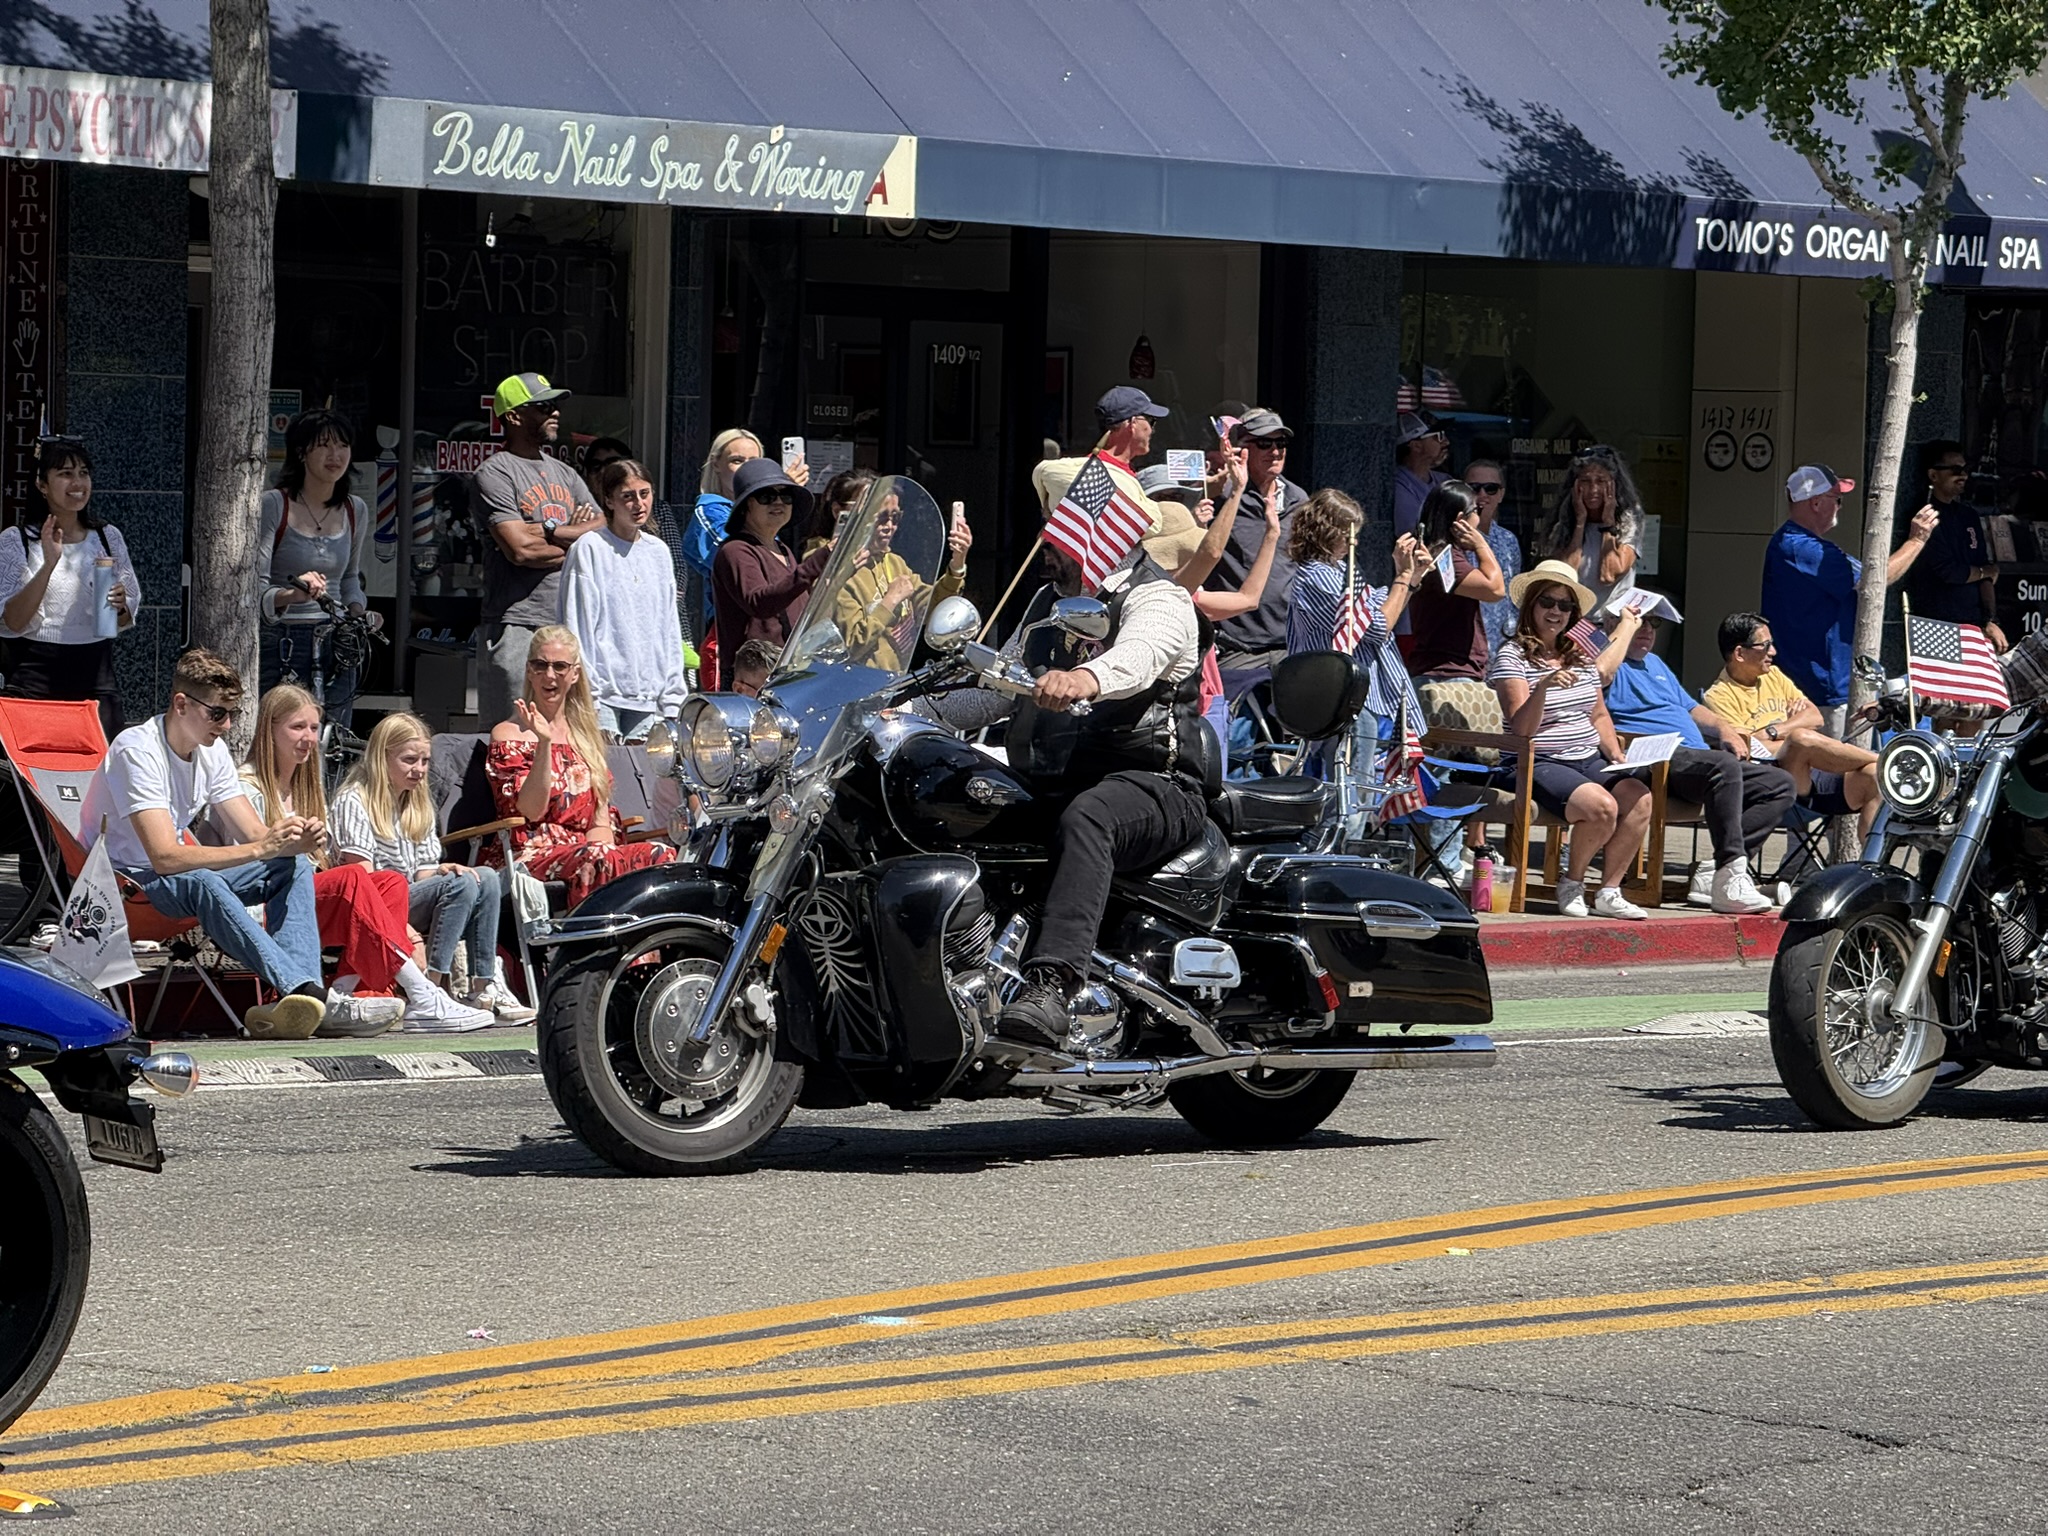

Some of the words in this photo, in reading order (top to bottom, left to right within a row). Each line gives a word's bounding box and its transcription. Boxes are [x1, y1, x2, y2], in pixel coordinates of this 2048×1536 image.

[26, 86, 178, 162] PSYCHIC
[433, 111, 541, 178] Bella
[543, 121, 632, 188] Nail
[640, 134, 704, 200] Spa
[714, 134, 744, 193] &
[749, 140, 865, 215] Waxing
[1696, 217, 1795, 257] TOMO'S
[1935, 233, 1989, 268] NAIL
[2000, 236, 2042, 271] SPA
[422, 248, 619, 319] BARBER
[453, 324, 589, 388] SHOP
[932, 343, 967, 365] 1409
[968, 349, 982, 361] 1/2
[813, 404, 849, 418] CLOSED
[1700, 405, 1735, 430] 1413
[1740, 406, 1773, 430] 1411
[1511, 437, 1549, 455] ORGANIC
[1552, 438, 1572, 455] NAIL
[520, 483, 549, 515] NEW
[2021, 611, 2042, 634] 10
